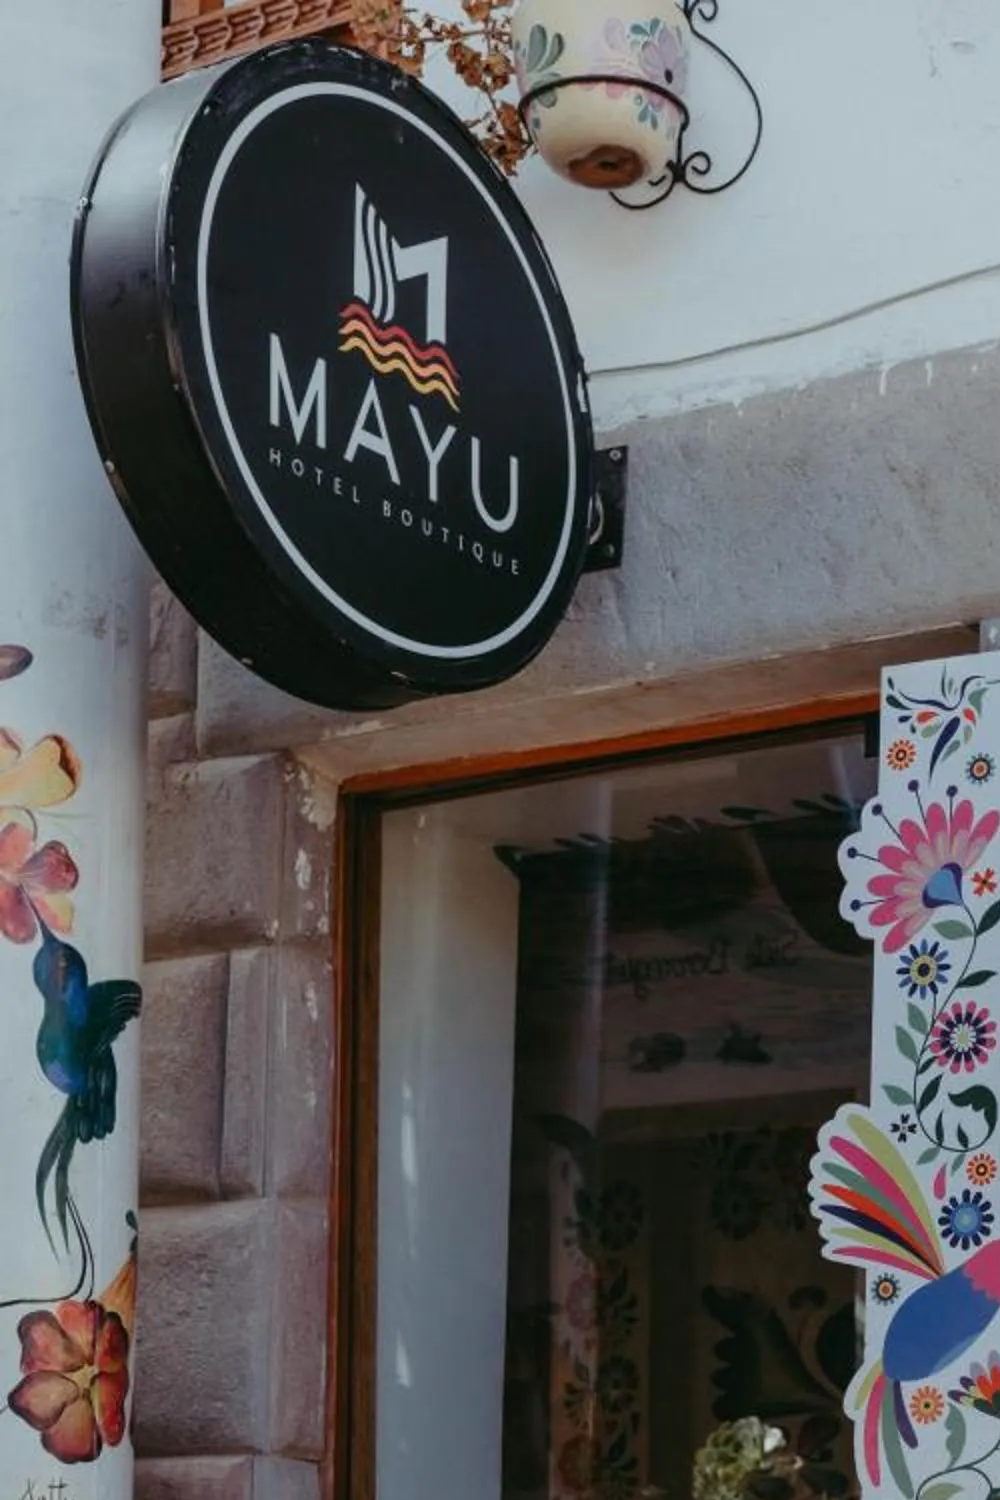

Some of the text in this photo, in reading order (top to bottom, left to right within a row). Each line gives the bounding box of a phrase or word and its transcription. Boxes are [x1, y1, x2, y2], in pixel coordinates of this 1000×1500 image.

[268, 447, 520, 576] HOTEL BOUTIQUE
[269, 332, 519, 533] MAYU
